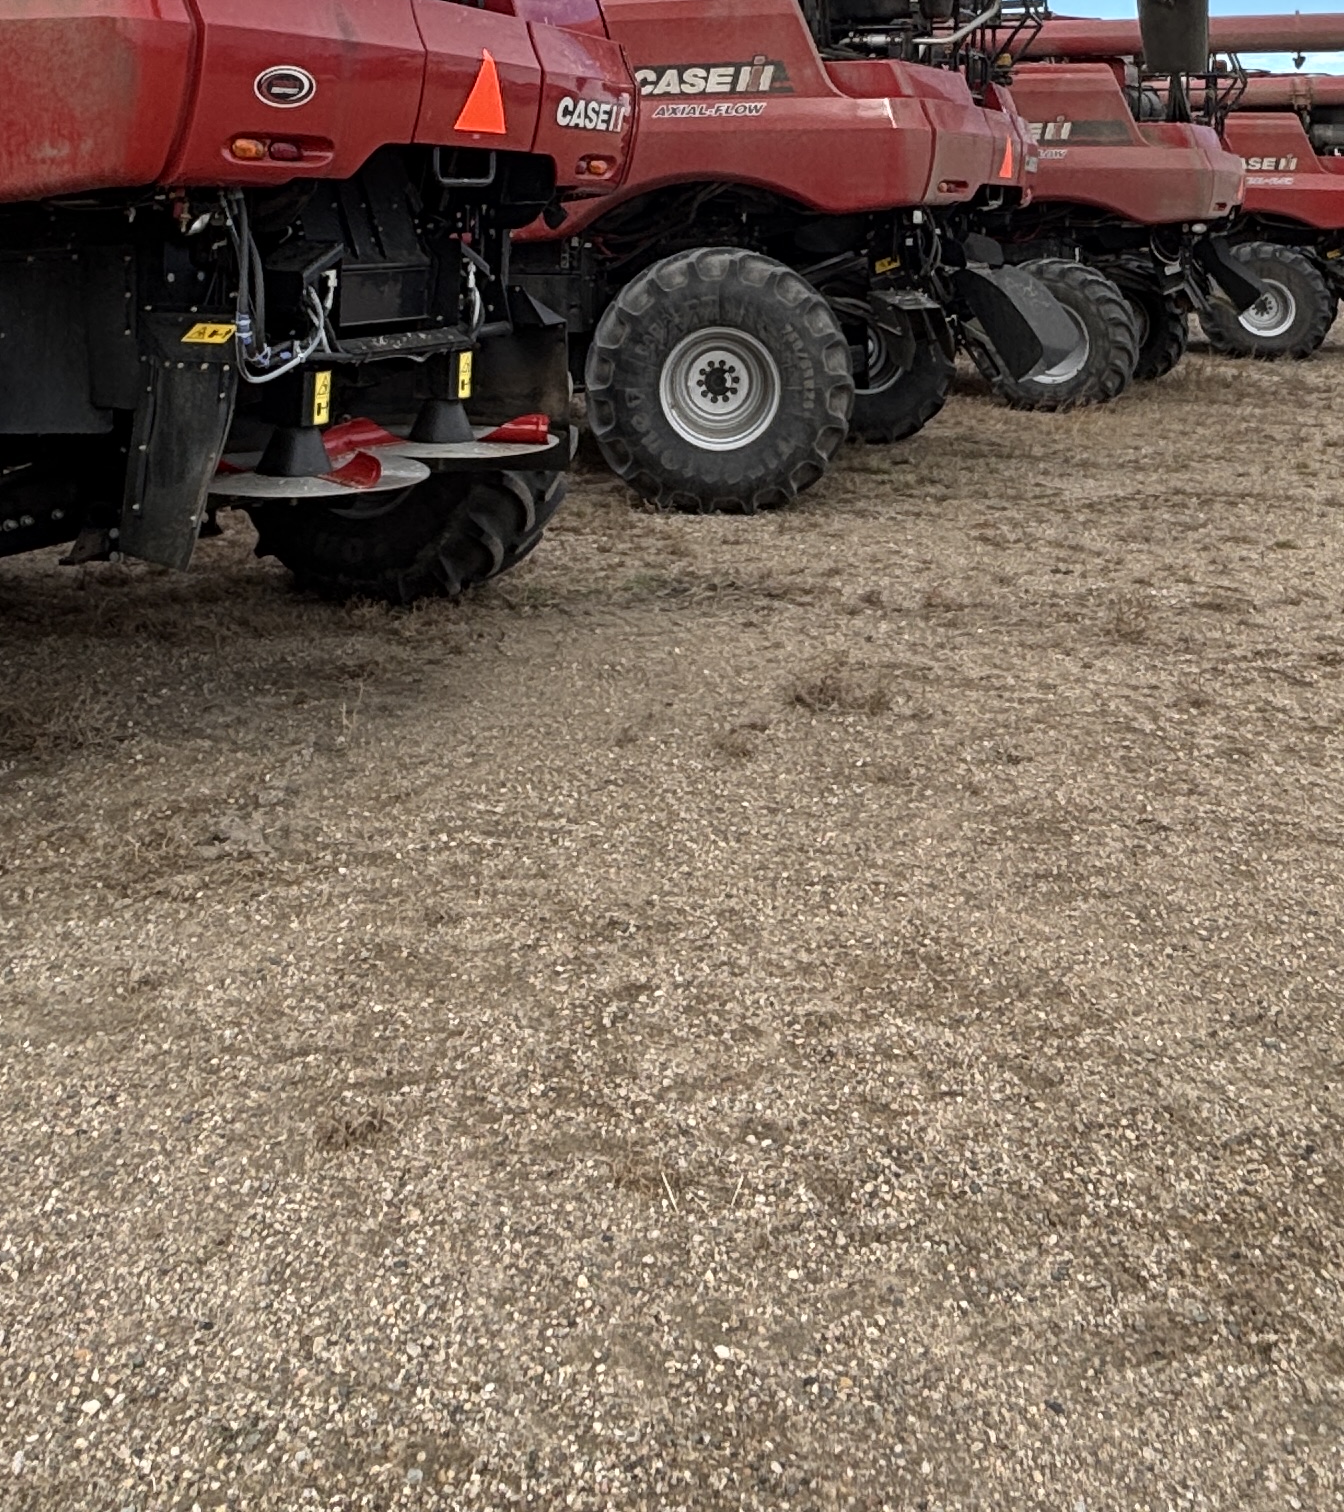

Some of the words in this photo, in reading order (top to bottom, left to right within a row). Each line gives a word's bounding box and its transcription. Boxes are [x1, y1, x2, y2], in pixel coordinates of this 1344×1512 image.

[635, 67, 732, 95] CASE
[557, 96, 612, 130] CASE
[652, 102, 767, 118] AXIAL-FLOW
[1240, 157, 1277, 170] SE
